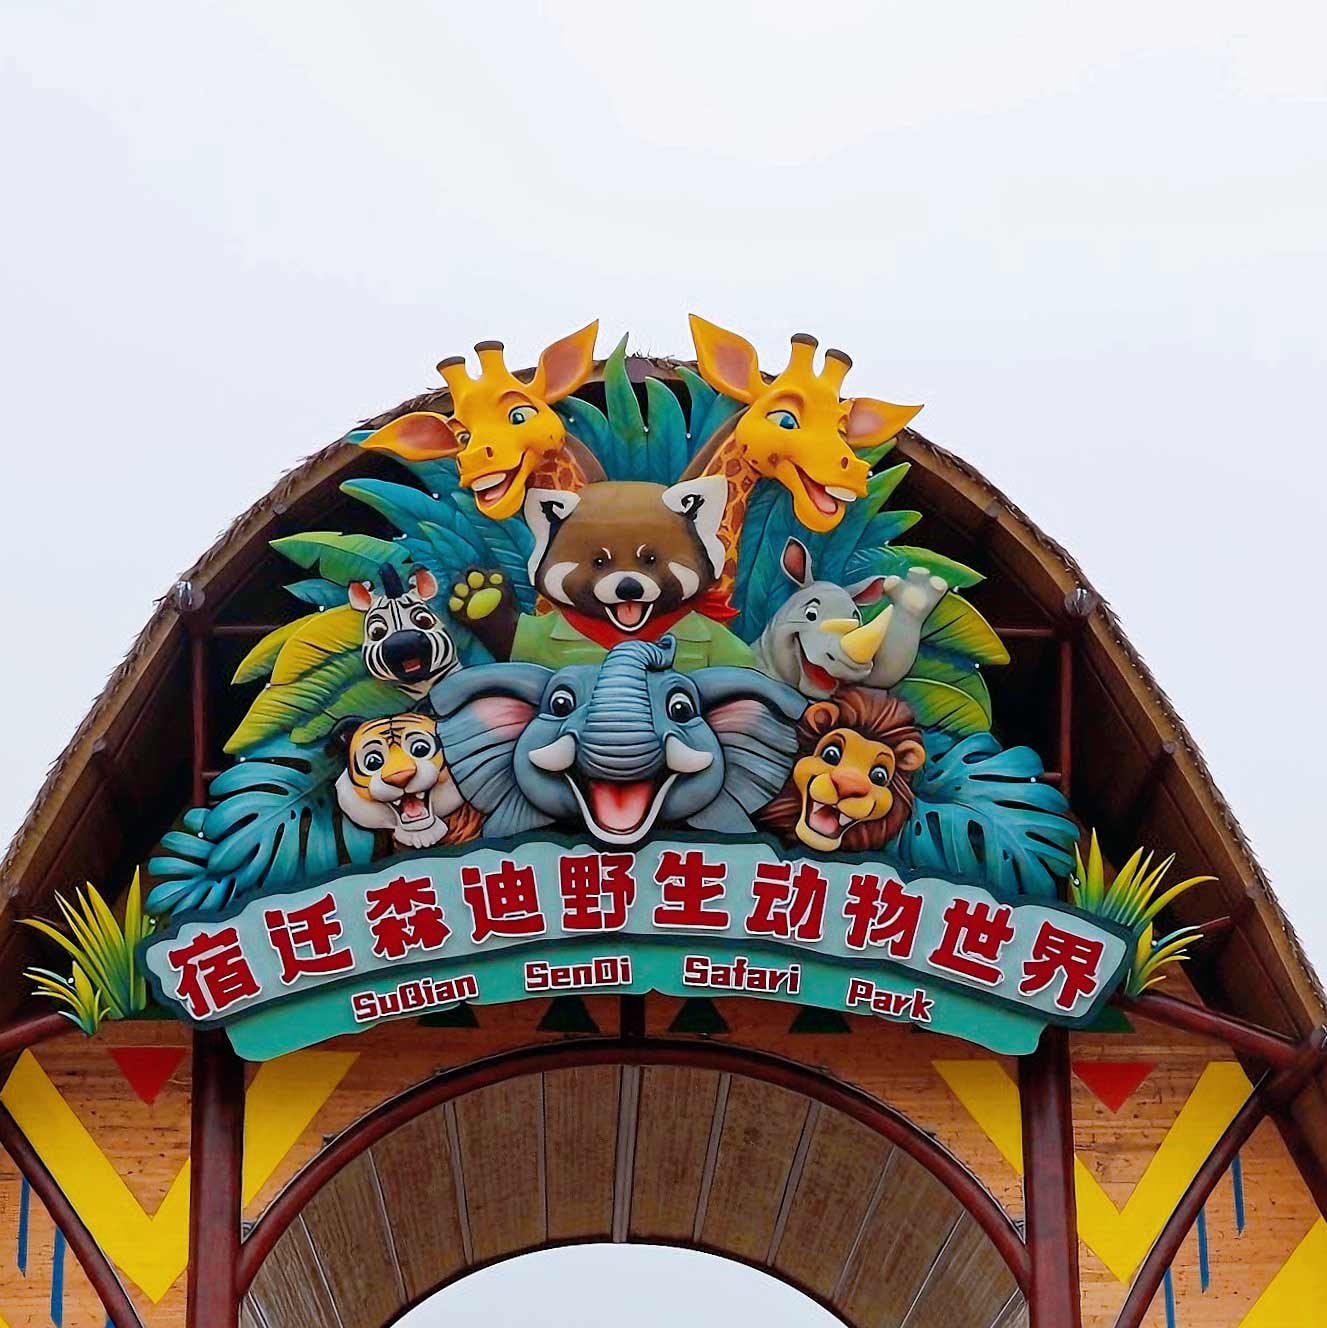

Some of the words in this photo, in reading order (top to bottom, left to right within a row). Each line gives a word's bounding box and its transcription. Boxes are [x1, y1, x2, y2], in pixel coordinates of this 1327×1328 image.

[168, 851, 1105, 1020] 宿迁森迪野生动物世界
[524, 956, 632, 991] SenDi
[682, 955, 801, 994] Safari
[846, 977, 934, 1022] Park
